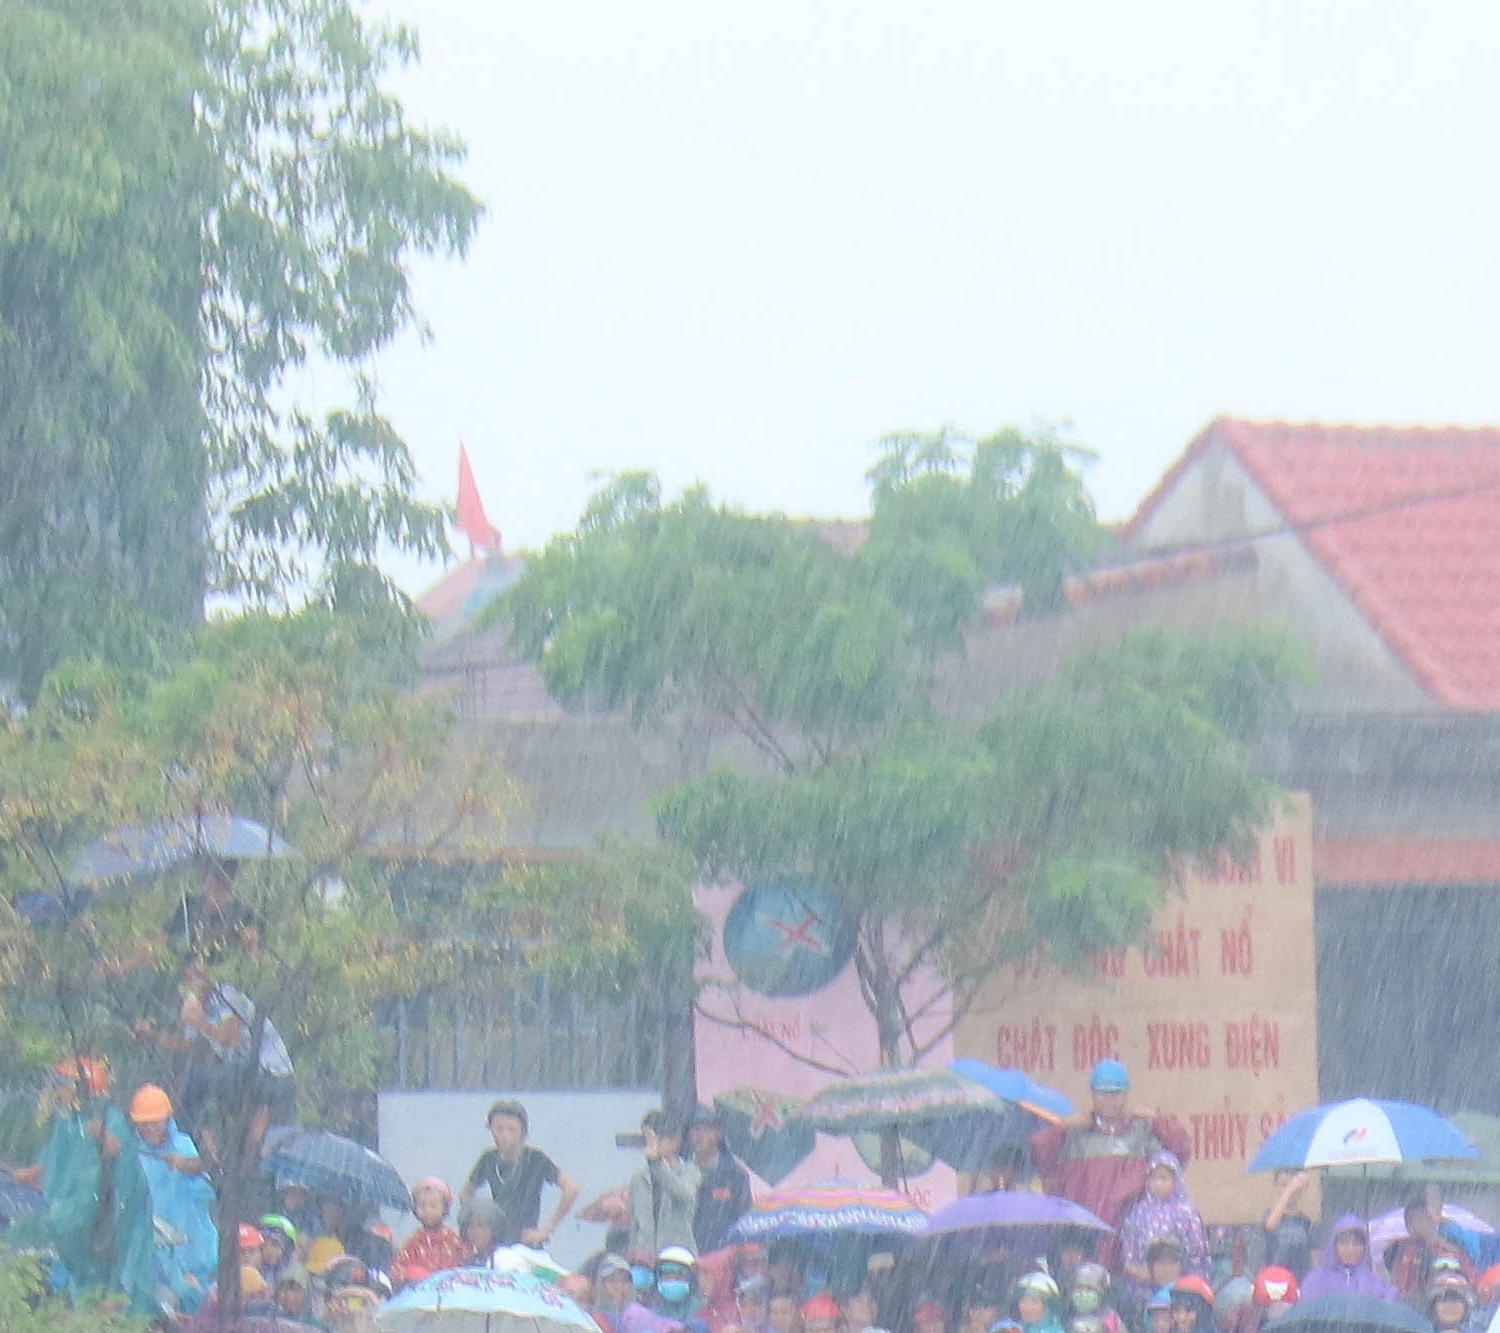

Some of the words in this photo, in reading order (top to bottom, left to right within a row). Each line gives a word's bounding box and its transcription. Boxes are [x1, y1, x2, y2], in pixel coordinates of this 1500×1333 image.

[1147, 1020, 1212, 1071] XUNG
[1225, 1012, 1281, 1078] ĐIỆN
[1191, 1095, 1249, 1161] THỦY
